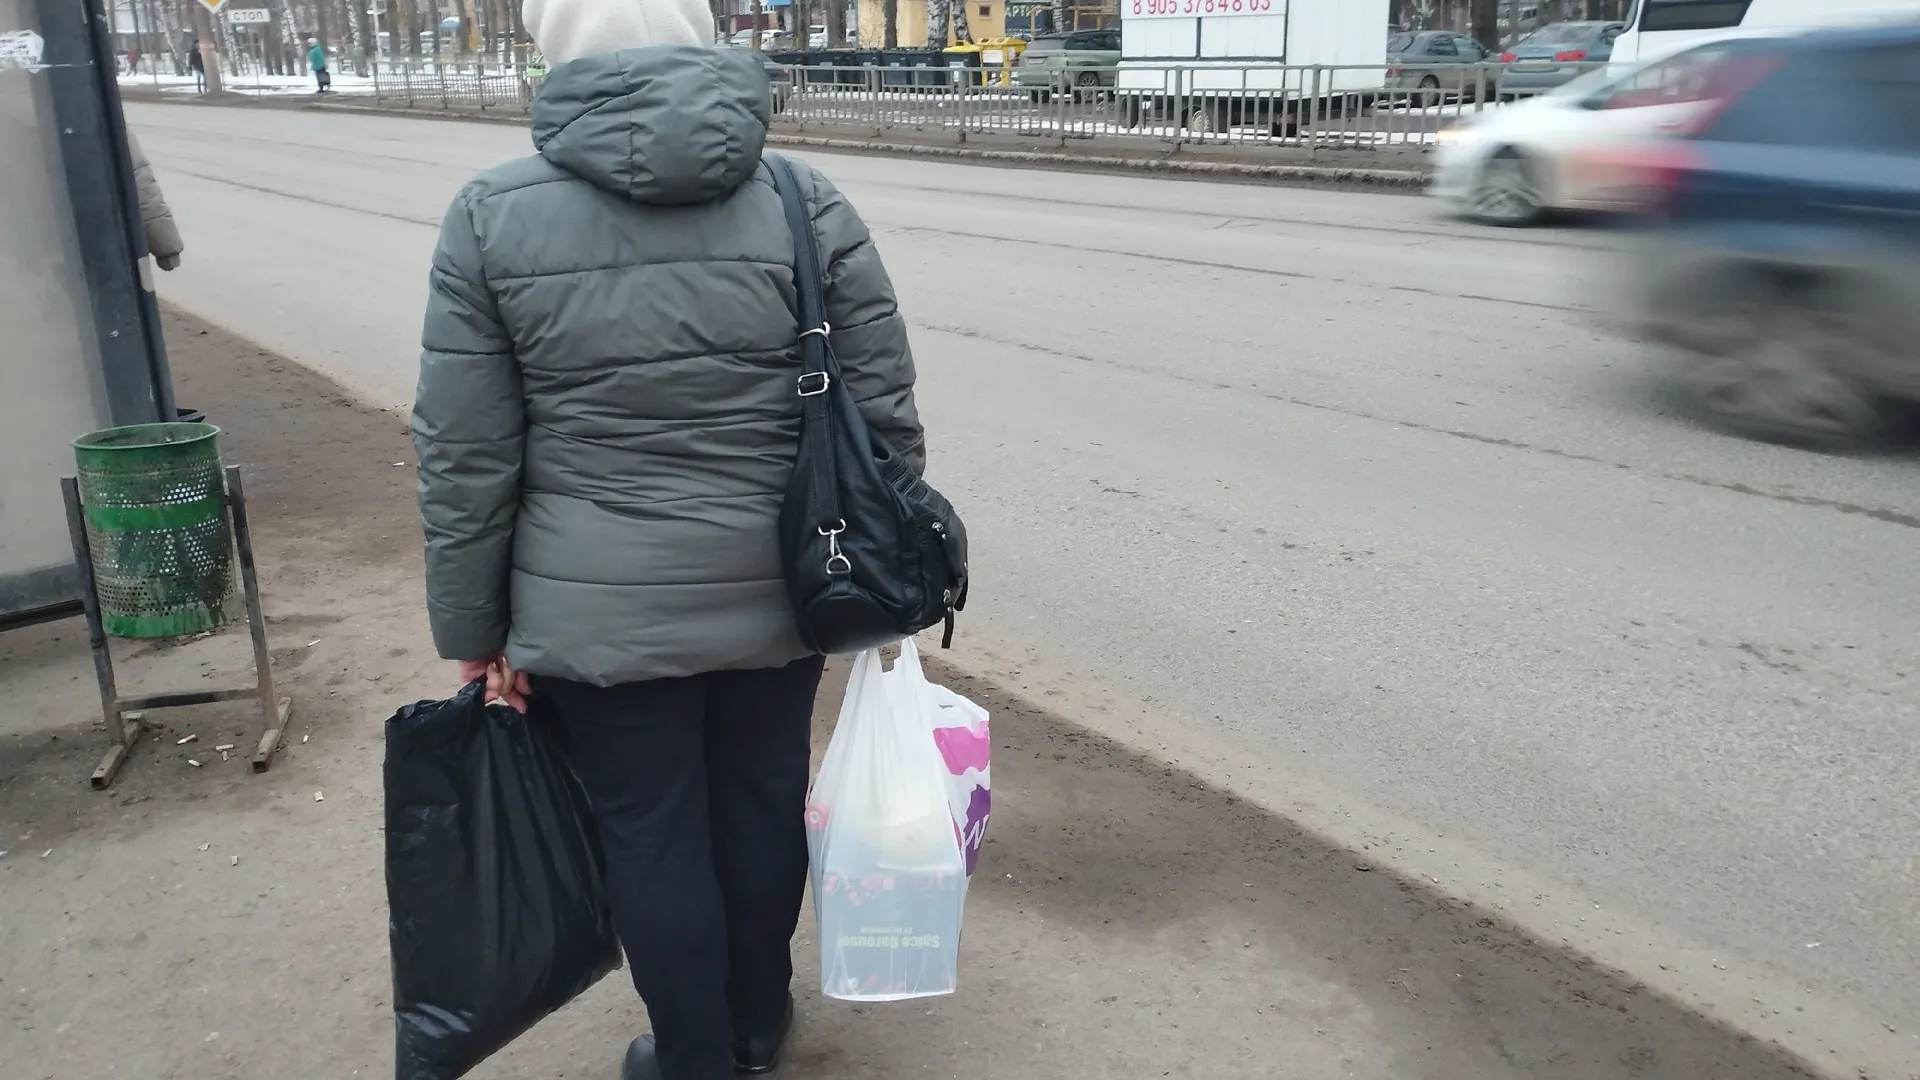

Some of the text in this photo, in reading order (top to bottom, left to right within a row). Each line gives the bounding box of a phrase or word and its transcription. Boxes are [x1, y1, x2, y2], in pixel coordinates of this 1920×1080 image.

[1133, 0, 1142, 15] 8
[1147, 0, 1178, 14] 905
[233, 12, 263, 21] СТОП
